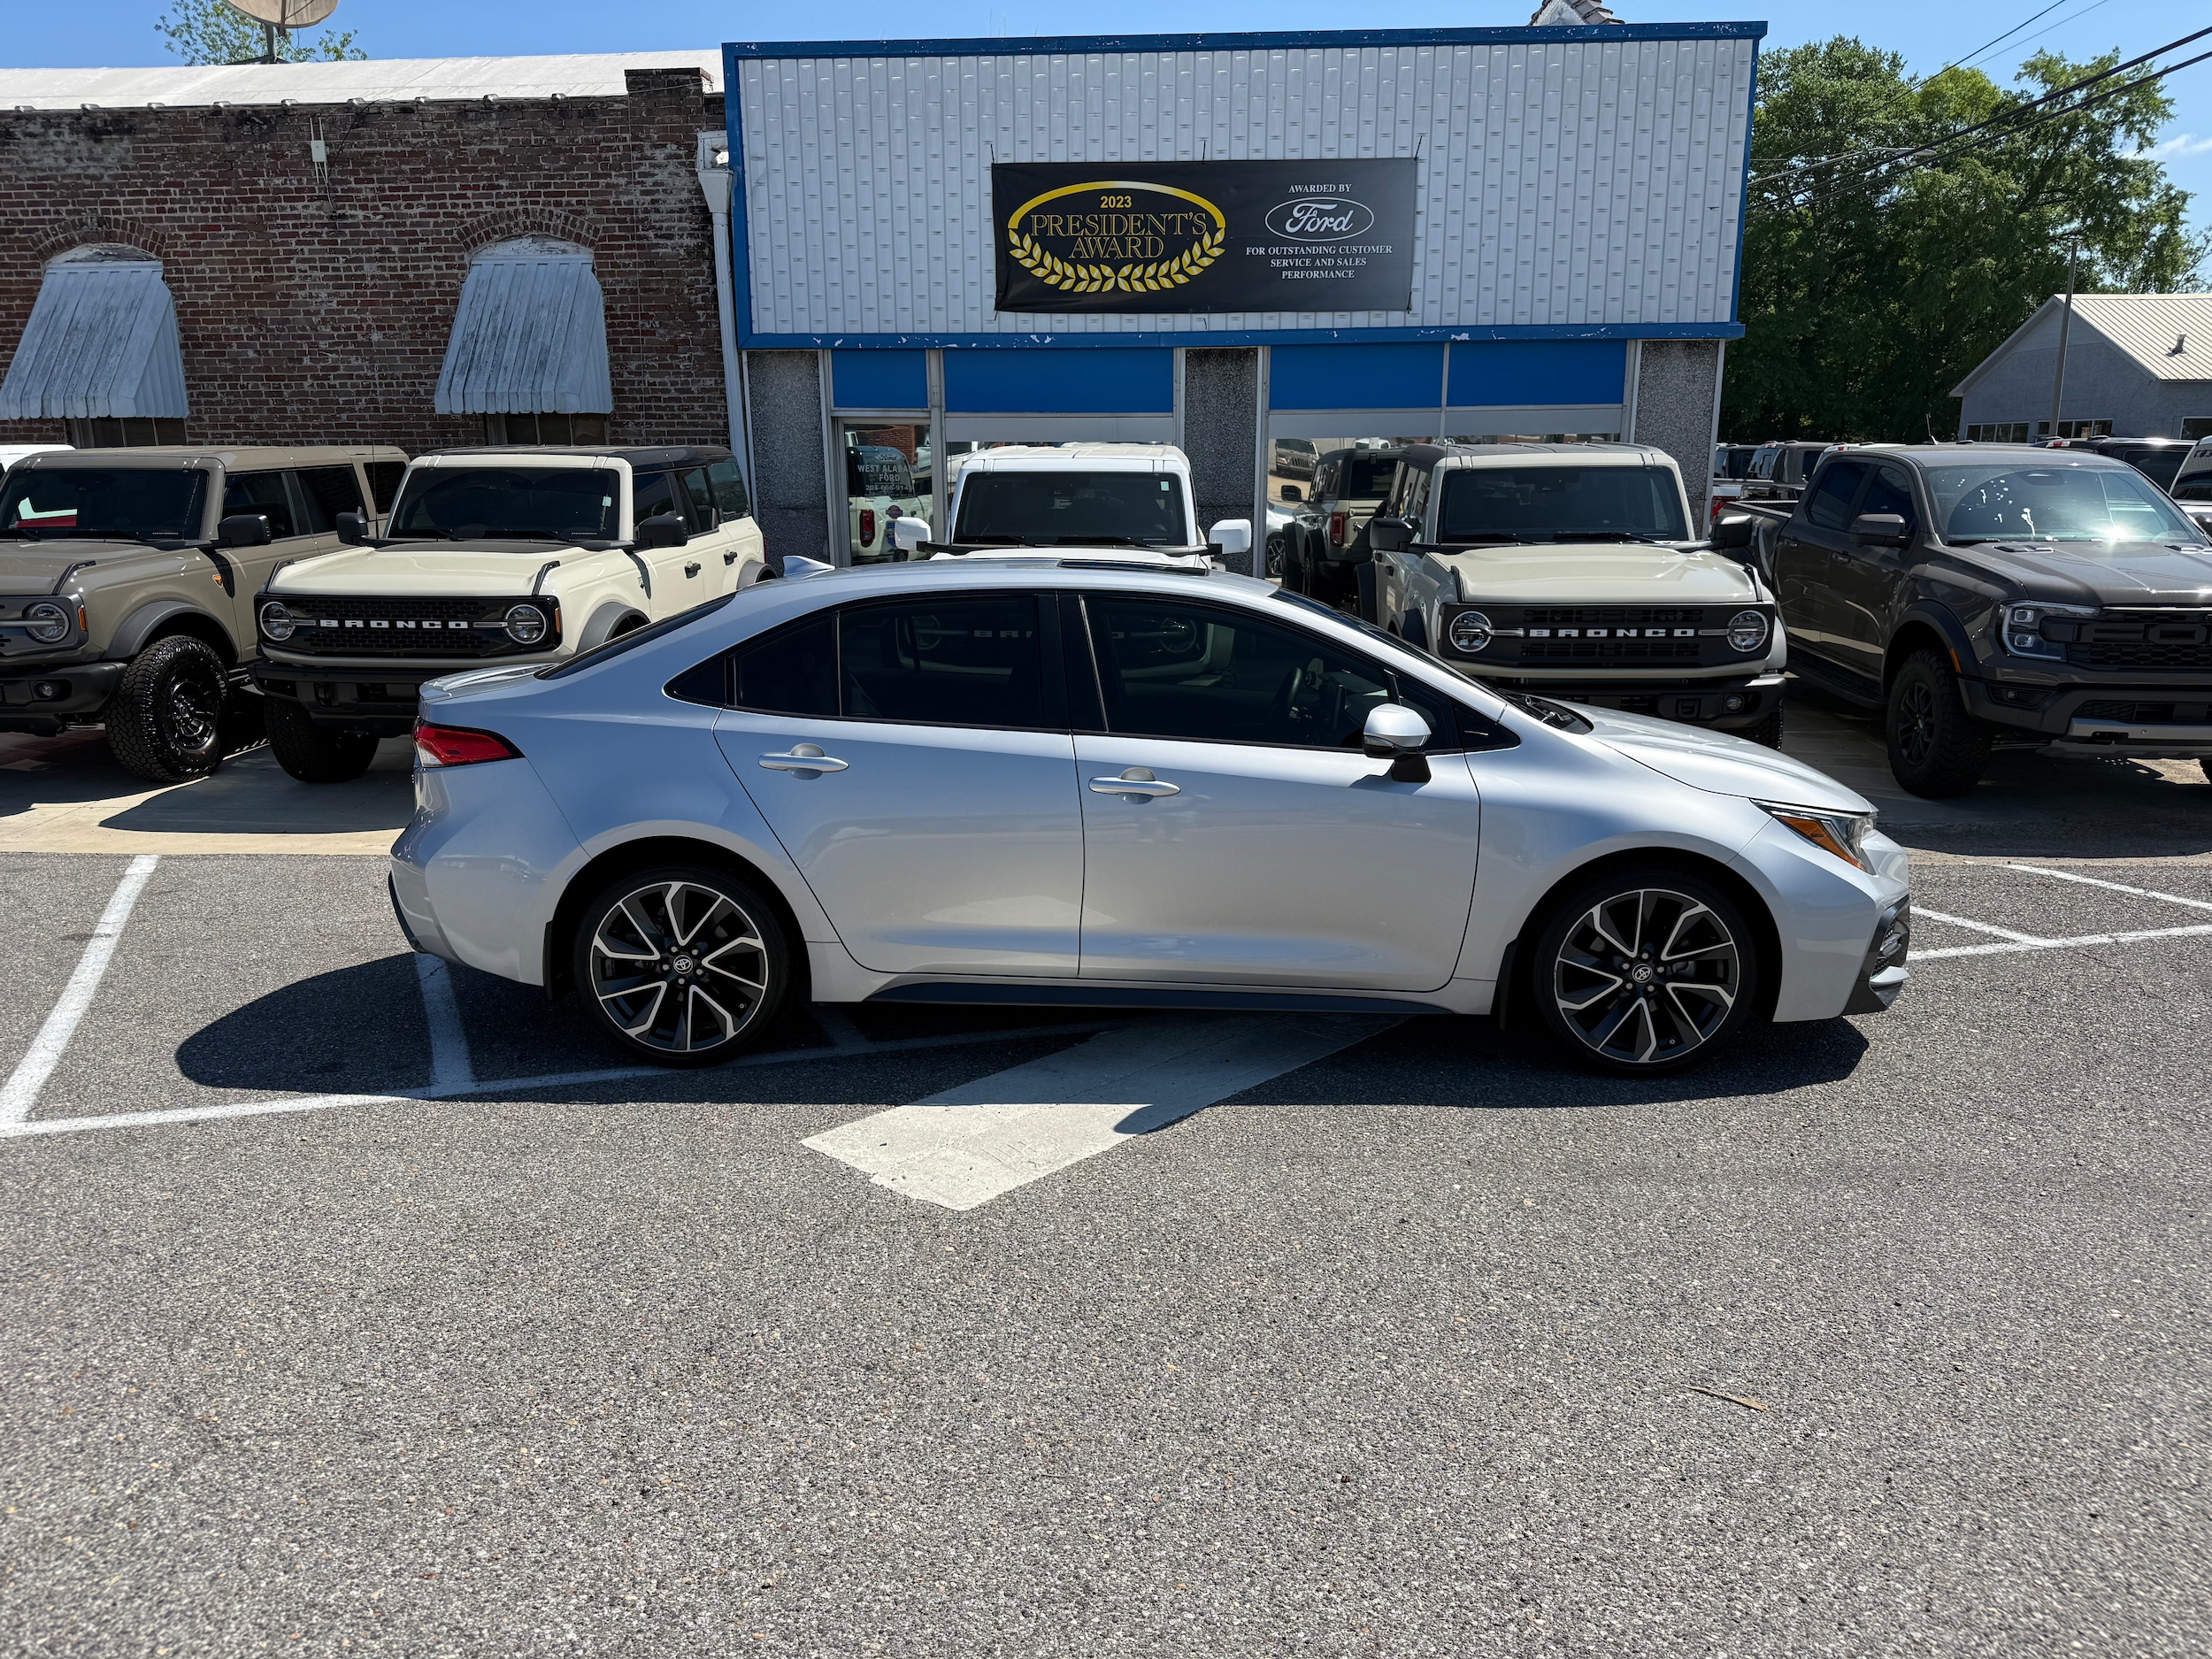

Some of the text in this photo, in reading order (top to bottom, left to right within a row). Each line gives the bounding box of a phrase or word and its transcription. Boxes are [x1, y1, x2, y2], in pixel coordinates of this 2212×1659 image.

[1288, 183, 1353, 194] AWARDED BY
[1100, 196, 1133, 209] 2023
[1030, 212, 1208, 236] PRESIDENT'S
[1285, 203, 1355, 234] Ford
[1068, 236, 1165, 258] AWARD
[1245, 245, 1393, 256] FOR OUTSTANDING CUSTOMER
[1270, 258, 1312, 267] SERVICE
[1336, 257, 1367, 266] SALES
[1281, 270, 1356, 280] PERFORMANCE
[320, 619, 469, 629] BRONCO
[1529, 628, 1695, 638] BRONCO
